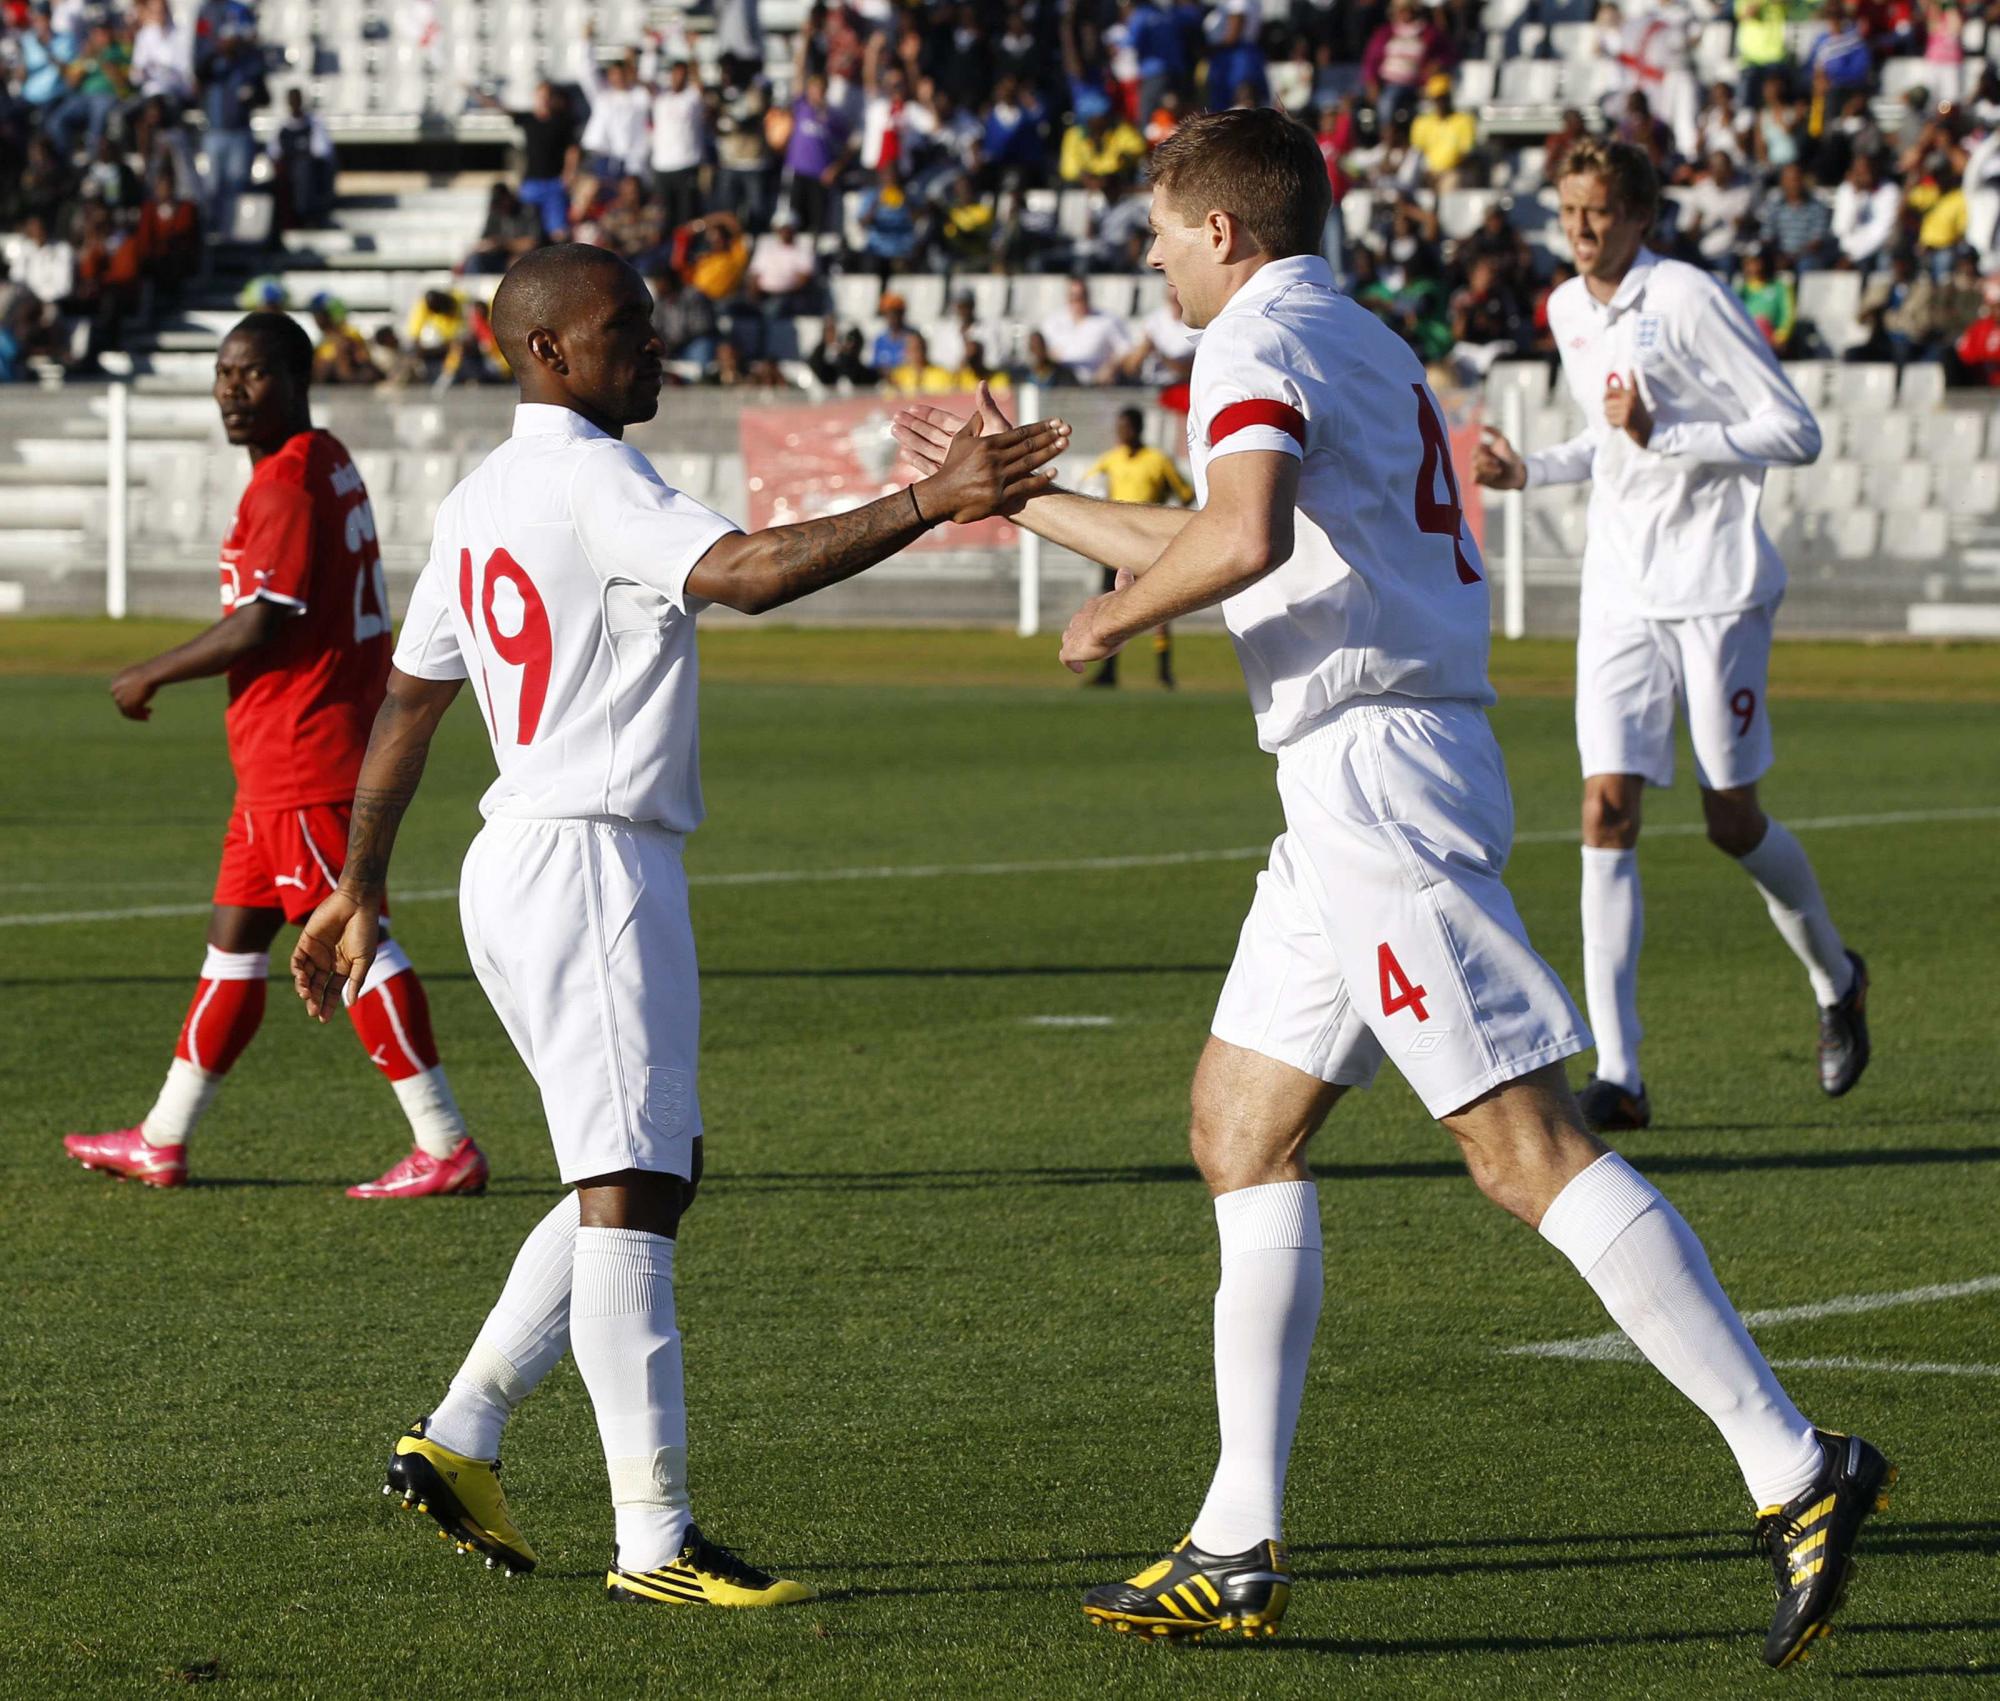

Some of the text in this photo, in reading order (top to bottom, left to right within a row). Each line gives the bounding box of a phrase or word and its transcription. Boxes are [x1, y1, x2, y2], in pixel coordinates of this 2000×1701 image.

[1411, 383, 1482, 585] 4
[459, 547, 553, 745] 19
[1731, 688, 1756, 737] 9
[1378, 942, 1430, 1023] 4
